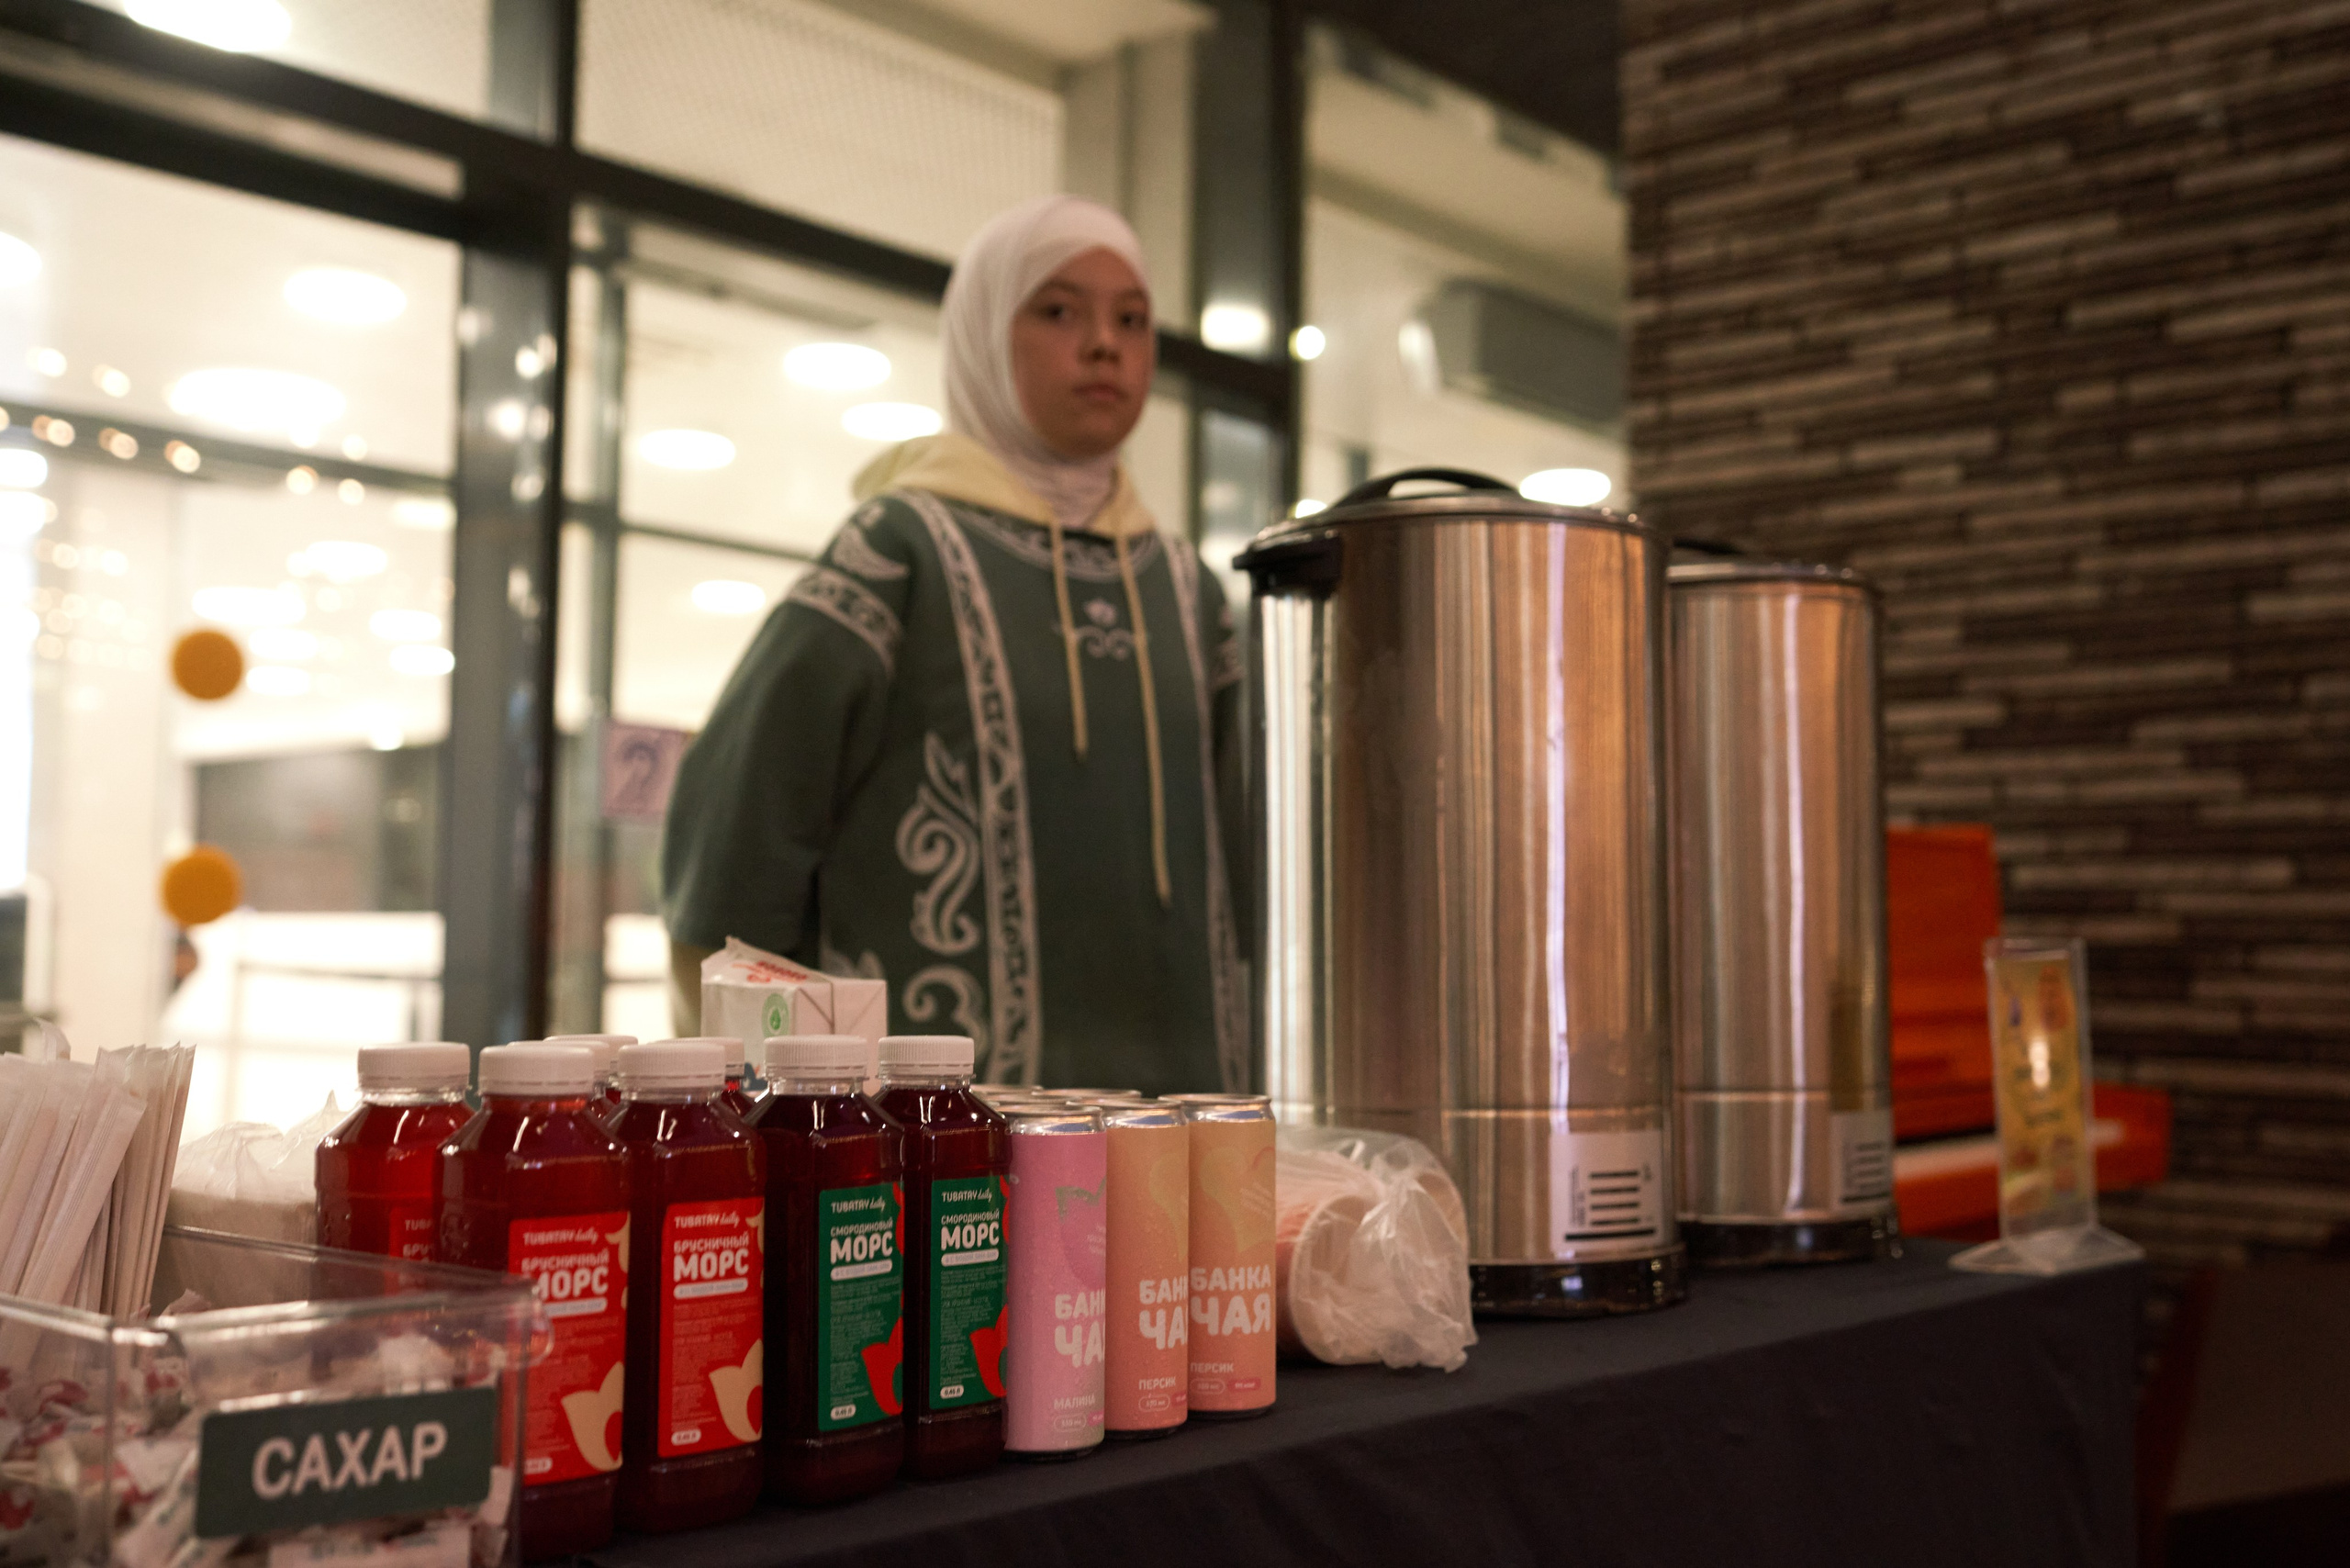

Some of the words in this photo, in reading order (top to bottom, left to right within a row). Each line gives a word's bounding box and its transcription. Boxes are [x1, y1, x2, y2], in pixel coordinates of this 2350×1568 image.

[831, 1199, 870, 1213] TUBATAY
[942, 1190, 978, 1203] TUBATAY
[831, 1216, 893, 1238] СМОРОДИНОВЫЙ
[941, 1208, 1000, 1226] СМОРОДИНОВЫЙ
[674, 1231, 750, 1254] БРУСНИЧНЫЙ
[831, 1231, 893, 1265] МОРС
[941, 1221, 1000, 1251] МОРС
[673, 1248, 749, 1282] МОРС
[1191, 1264, 1271, 1292] БАНКА
[1139, 1305, 1188, 1350] ЧА
[1191, 1293, 1271, 1337] ЧАЯ
[1055, 1320, 1105, 1368] ЧА
[1191, 1362, 1234, 1374] ПЕРСИК
[1139, 1376, 1176, 1391] ПЕРСИК
[1054, 1393, 1095, 1410] МАЛИНА
[252, 1421, 448, 1501] САХАР
